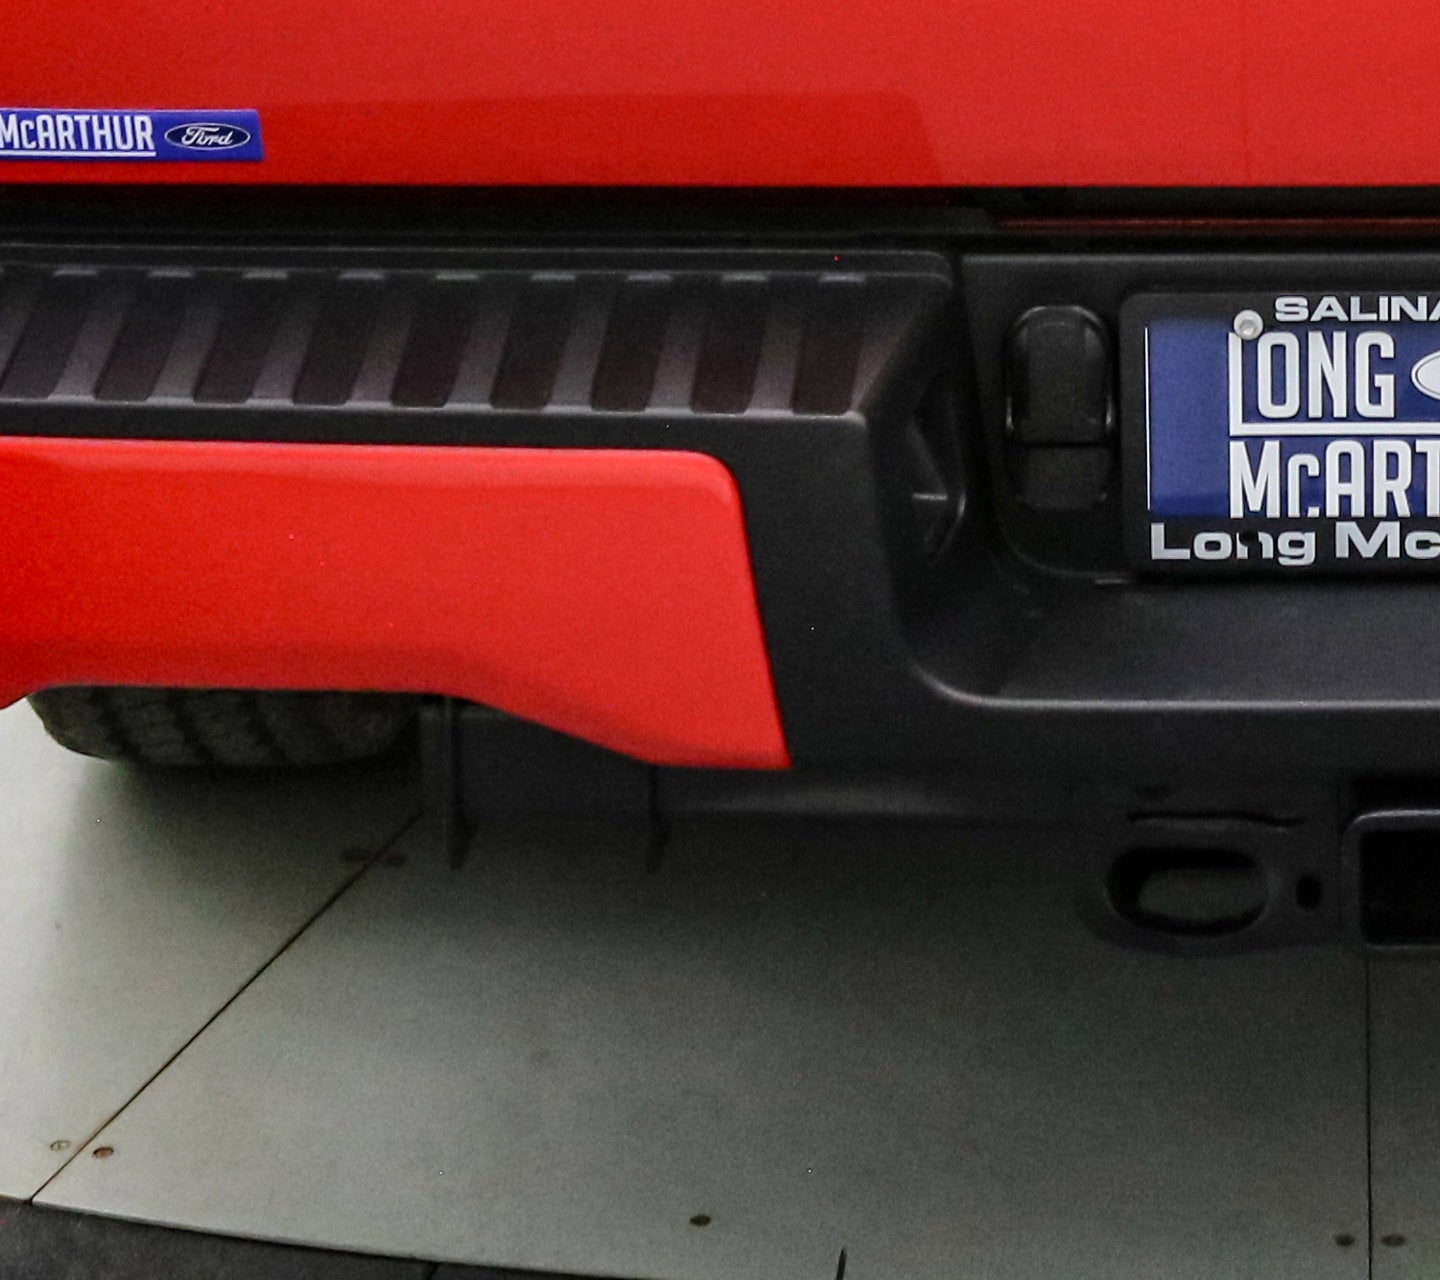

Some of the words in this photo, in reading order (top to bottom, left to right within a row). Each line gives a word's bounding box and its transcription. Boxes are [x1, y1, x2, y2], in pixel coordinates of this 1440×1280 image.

[180, 125, 234, 147] Ford
[1227, 330, 1396, 437] LONG
[1150, 522, 1317, 567] Long
